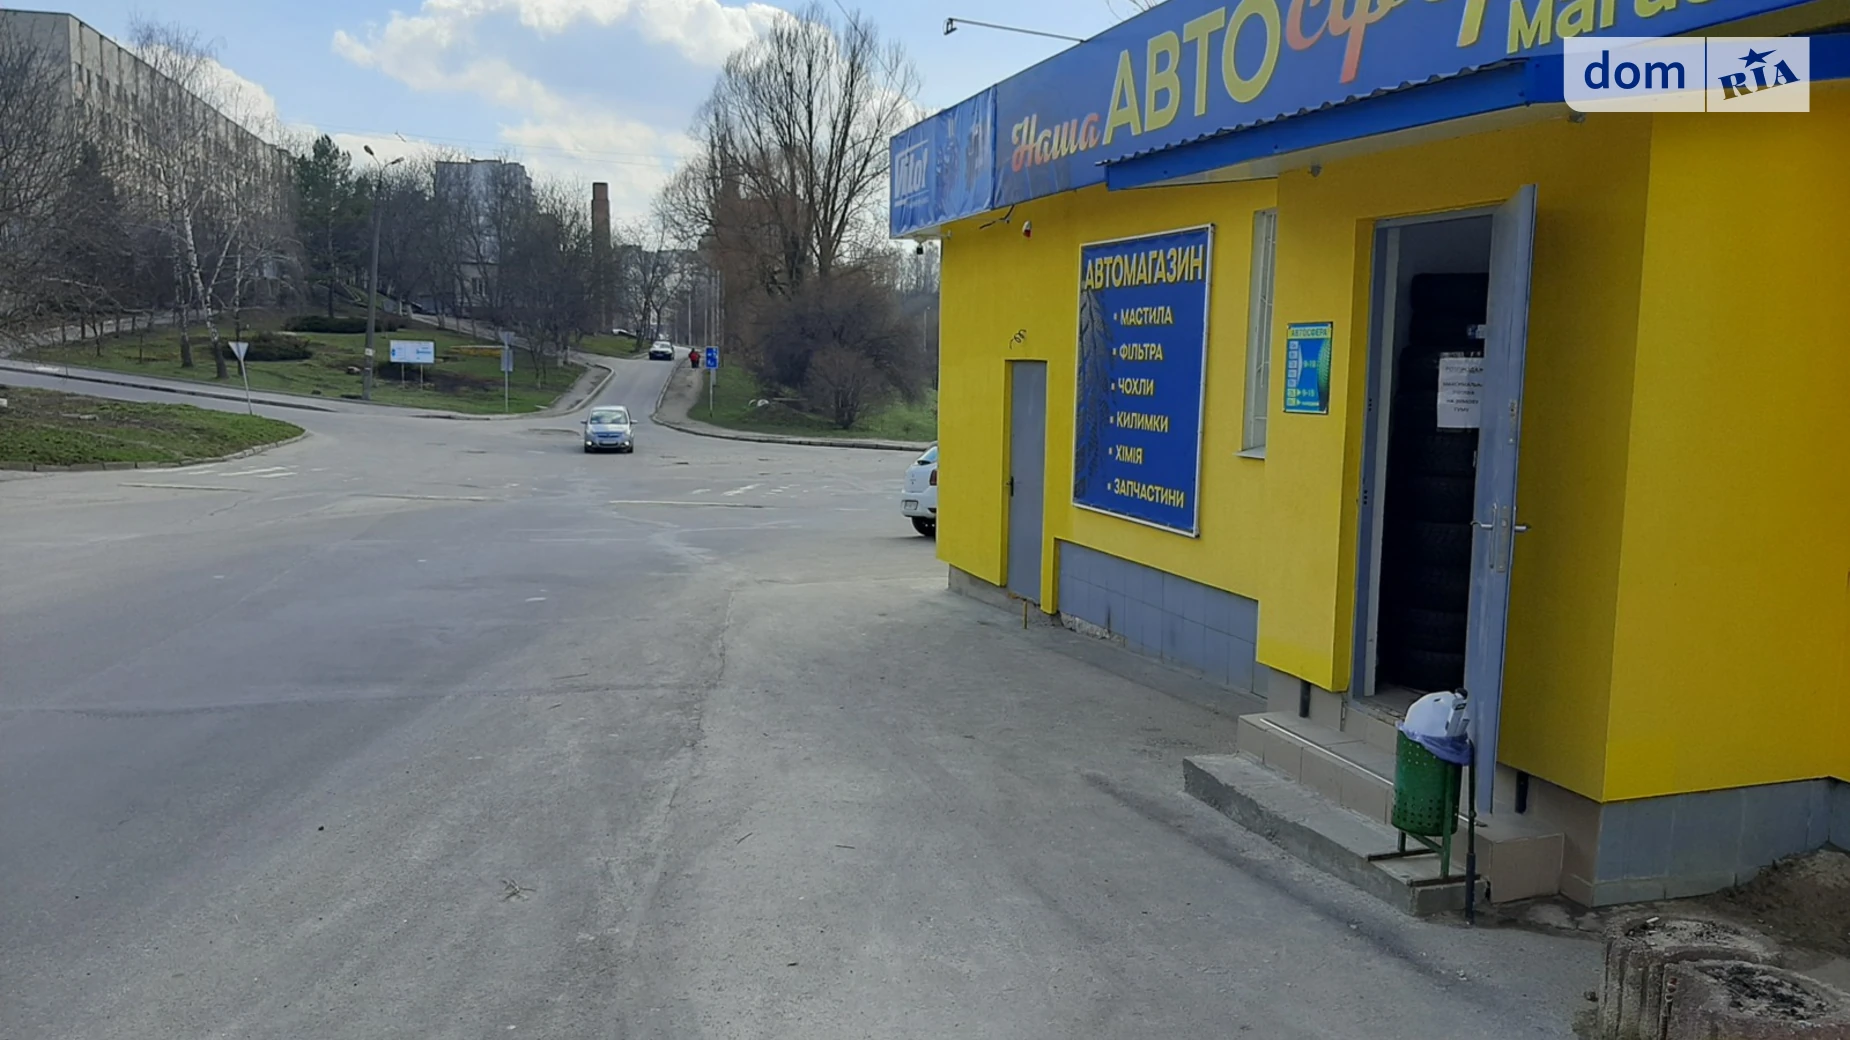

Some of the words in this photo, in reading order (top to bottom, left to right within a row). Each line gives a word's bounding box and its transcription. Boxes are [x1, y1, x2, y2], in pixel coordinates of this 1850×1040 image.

[1012, 113, 1101, 173] Наша
[1084, 244, 1205, 290] АВТОМАГАЗИН
[1119, 306, 1174, 326] МАСТИЛА
[1118, 343, 1163, 362] ФІЛЬТРА
[1117, 377, 1155, 396] ЧОХЛИ
[1116, 411, 1169, 433] КИЛИМКИ
[1115, 445, 1144, 465] ХІМІЯ
[1113, 478, 1185, 509] ЗАПЧАСТИНИ
